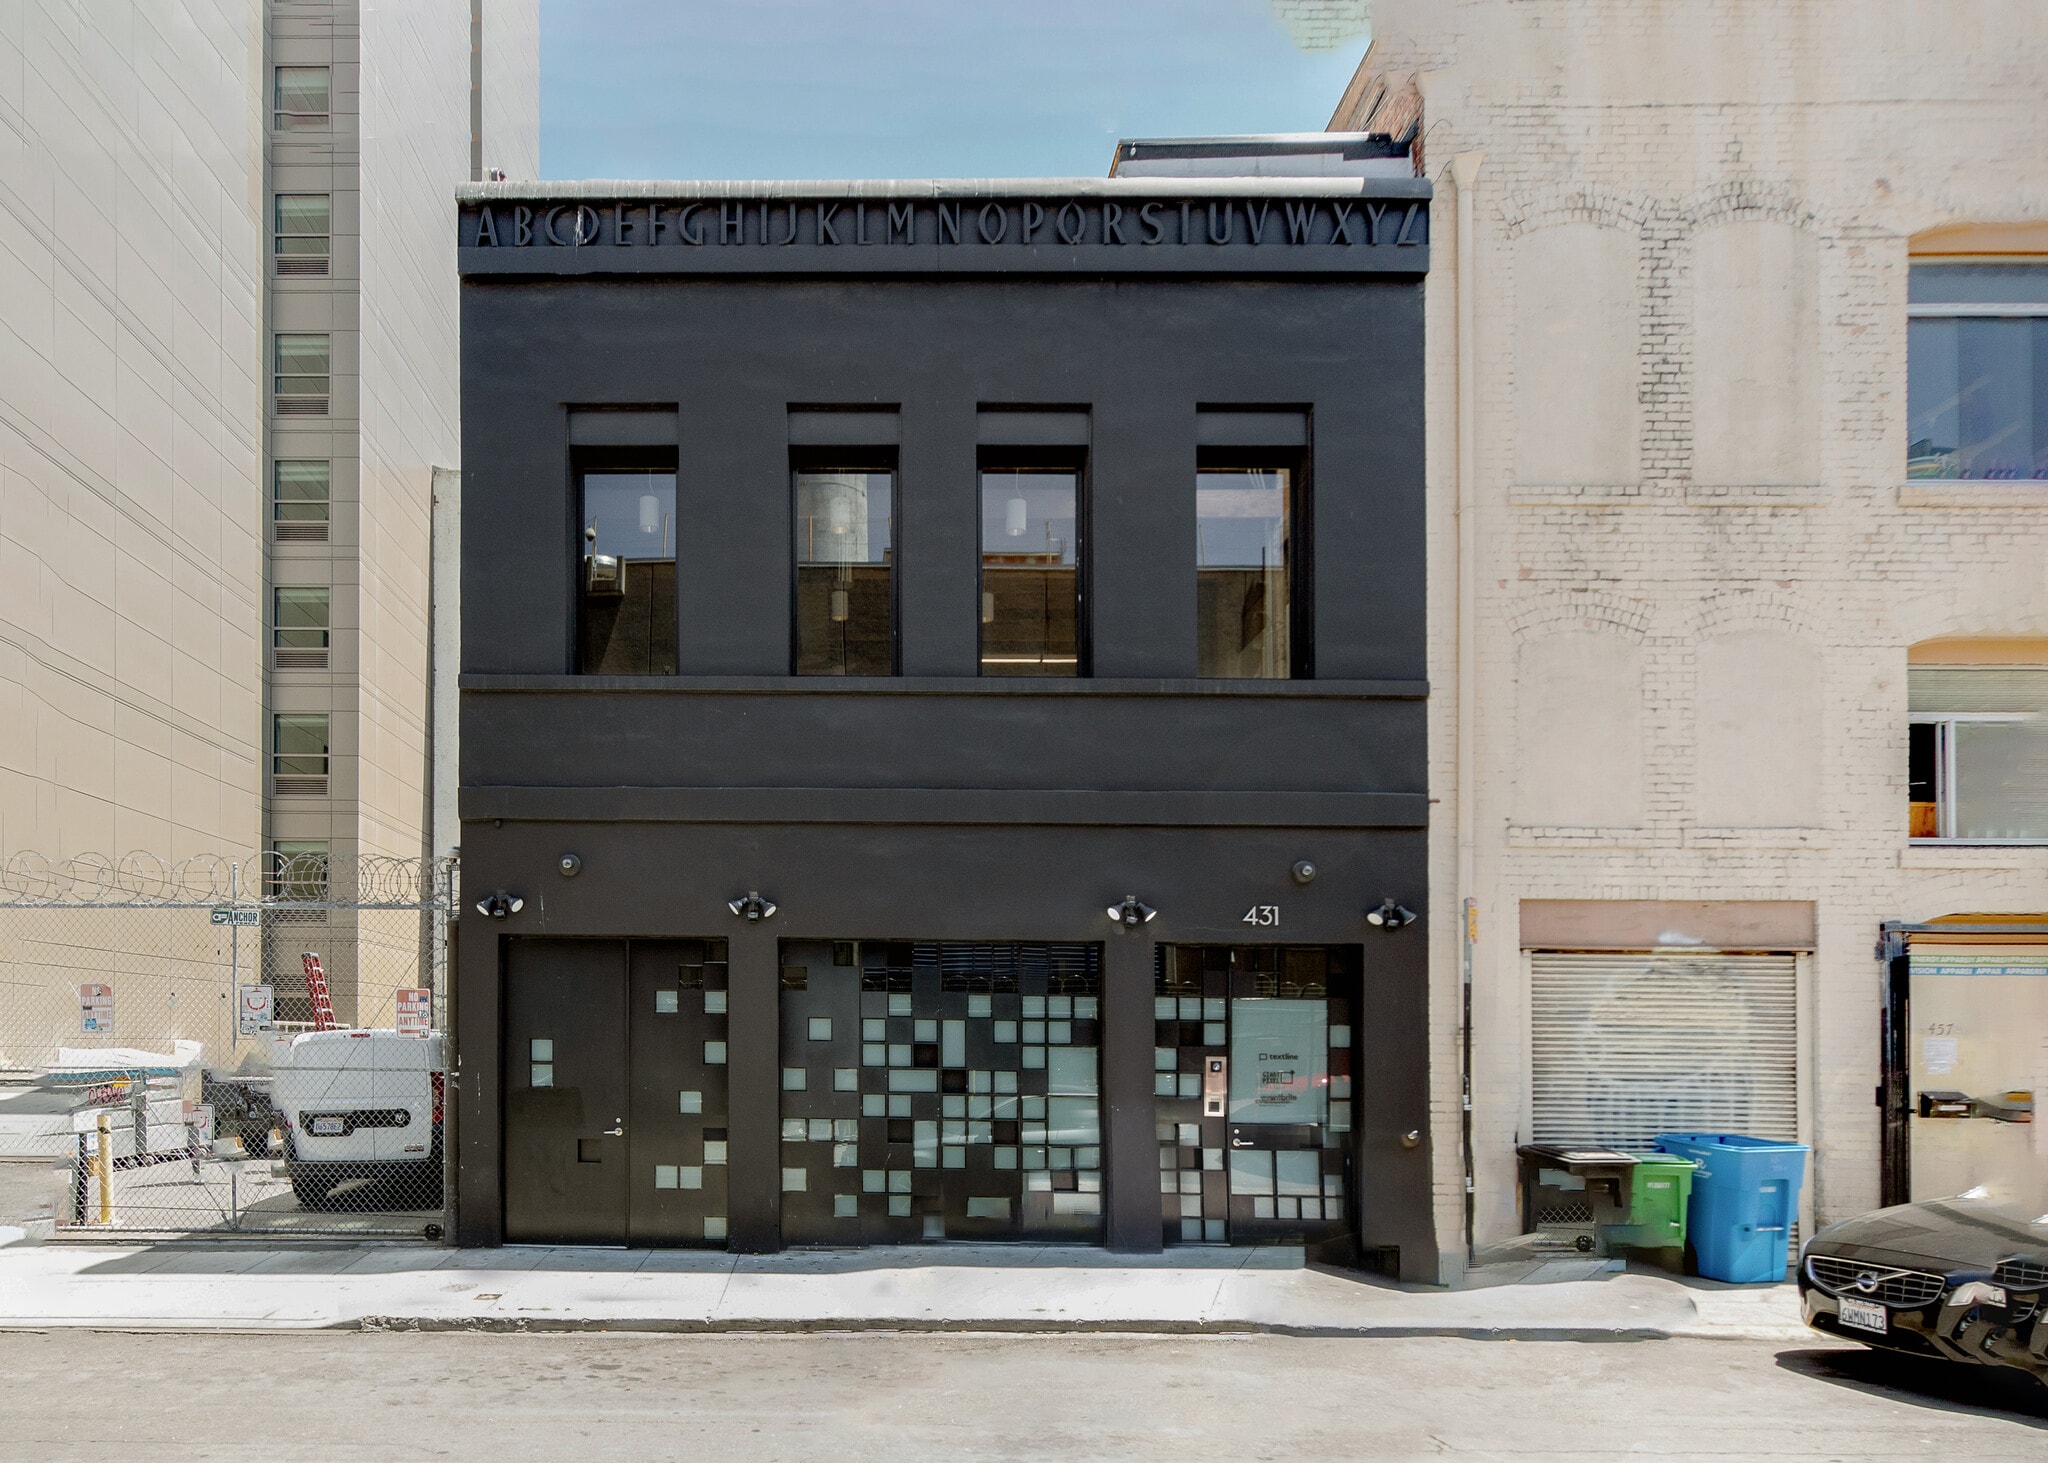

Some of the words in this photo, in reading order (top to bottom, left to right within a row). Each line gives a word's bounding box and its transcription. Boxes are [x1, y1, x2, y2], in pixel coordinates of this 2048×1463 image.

[228, 910, 258, 924] ANCHOR
[1242, 905, 1279, 926] 431
[82, 996, 112, 1006] PARKING
[408, 992, 419, 1002] NO
[397, 1002, 429, 1012] PARKING
[1928, 1022, 1954, 1036] 457
[1269, 1052, 1299, 1061] textline
